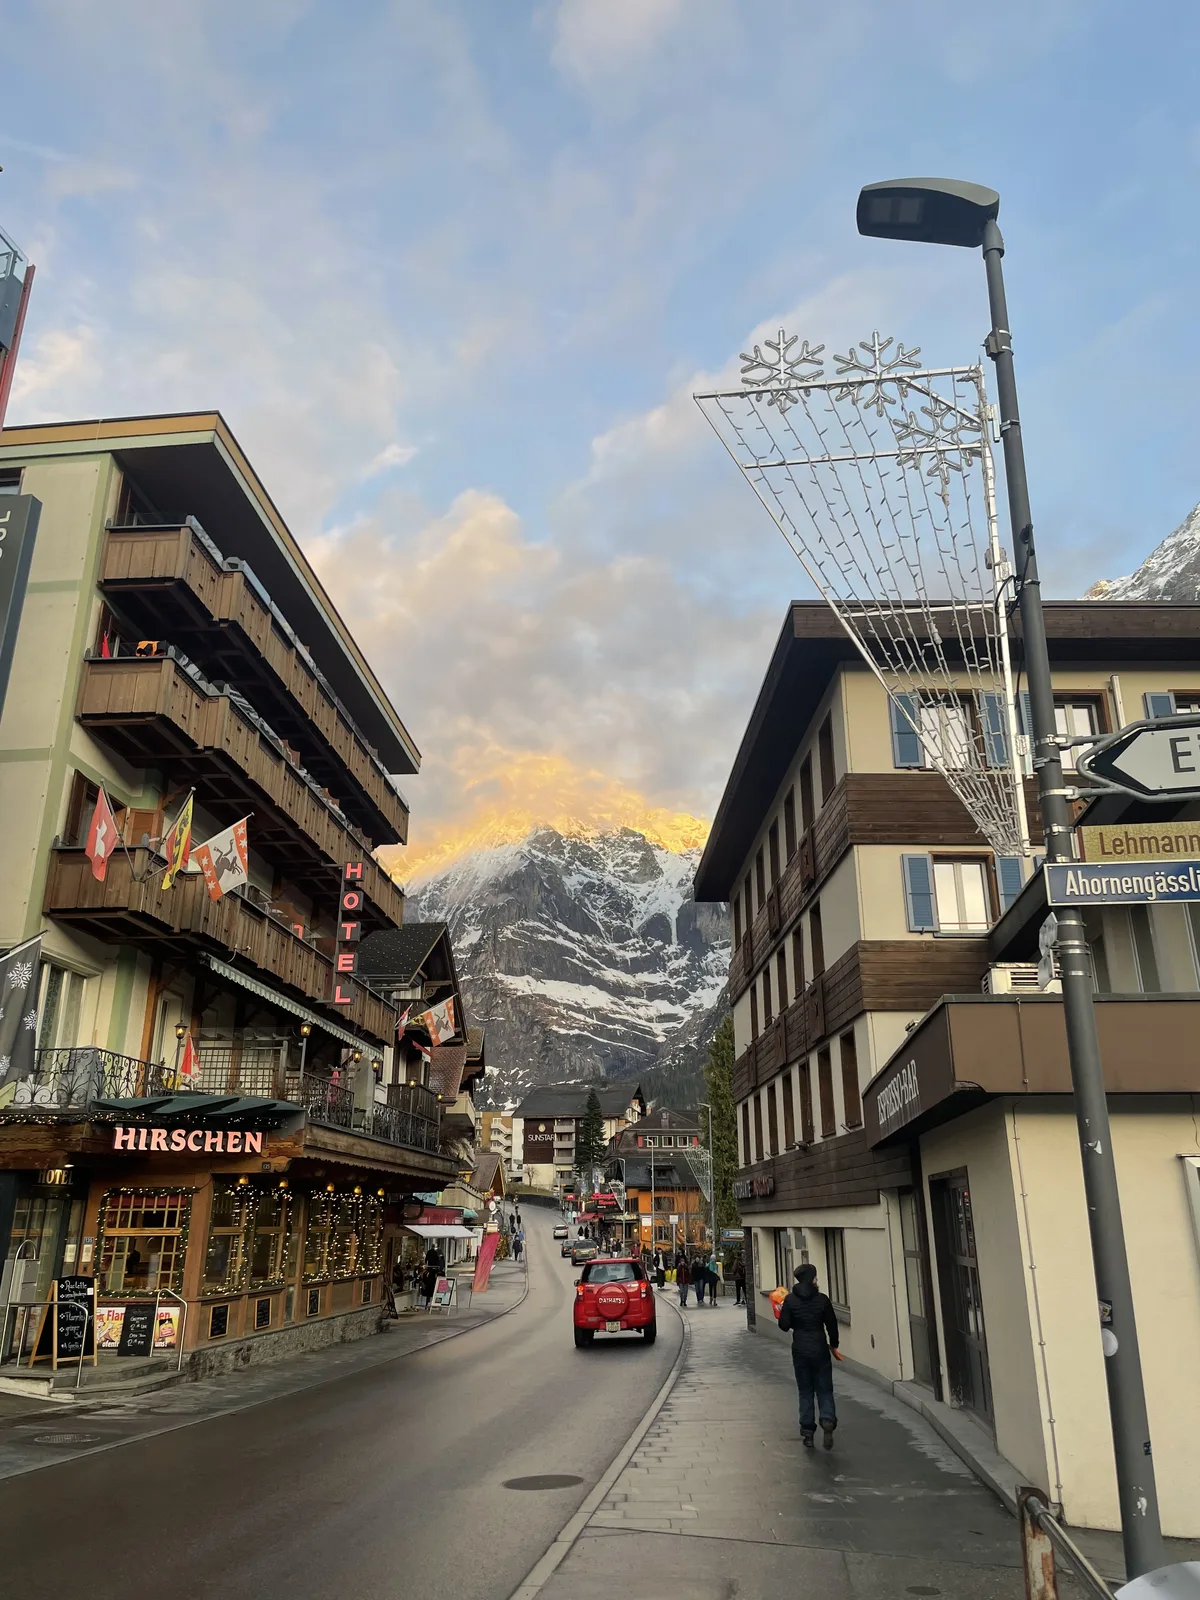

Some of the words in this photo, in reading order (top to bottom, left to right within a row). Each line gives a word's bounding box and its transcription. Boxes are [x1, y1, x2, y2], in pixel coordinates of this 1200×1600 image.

[1169, 734, 1200, 773] E
[1099, 831, 1200, 855] Lehmann
[334, 862, 363, 1003] HOTEL
[113, 1127, 263, 1153] HIRSCHEN
[528, 1133, 556, 1142] SUNSTAR
[38, 1168, 74, 1185] HOTEL
